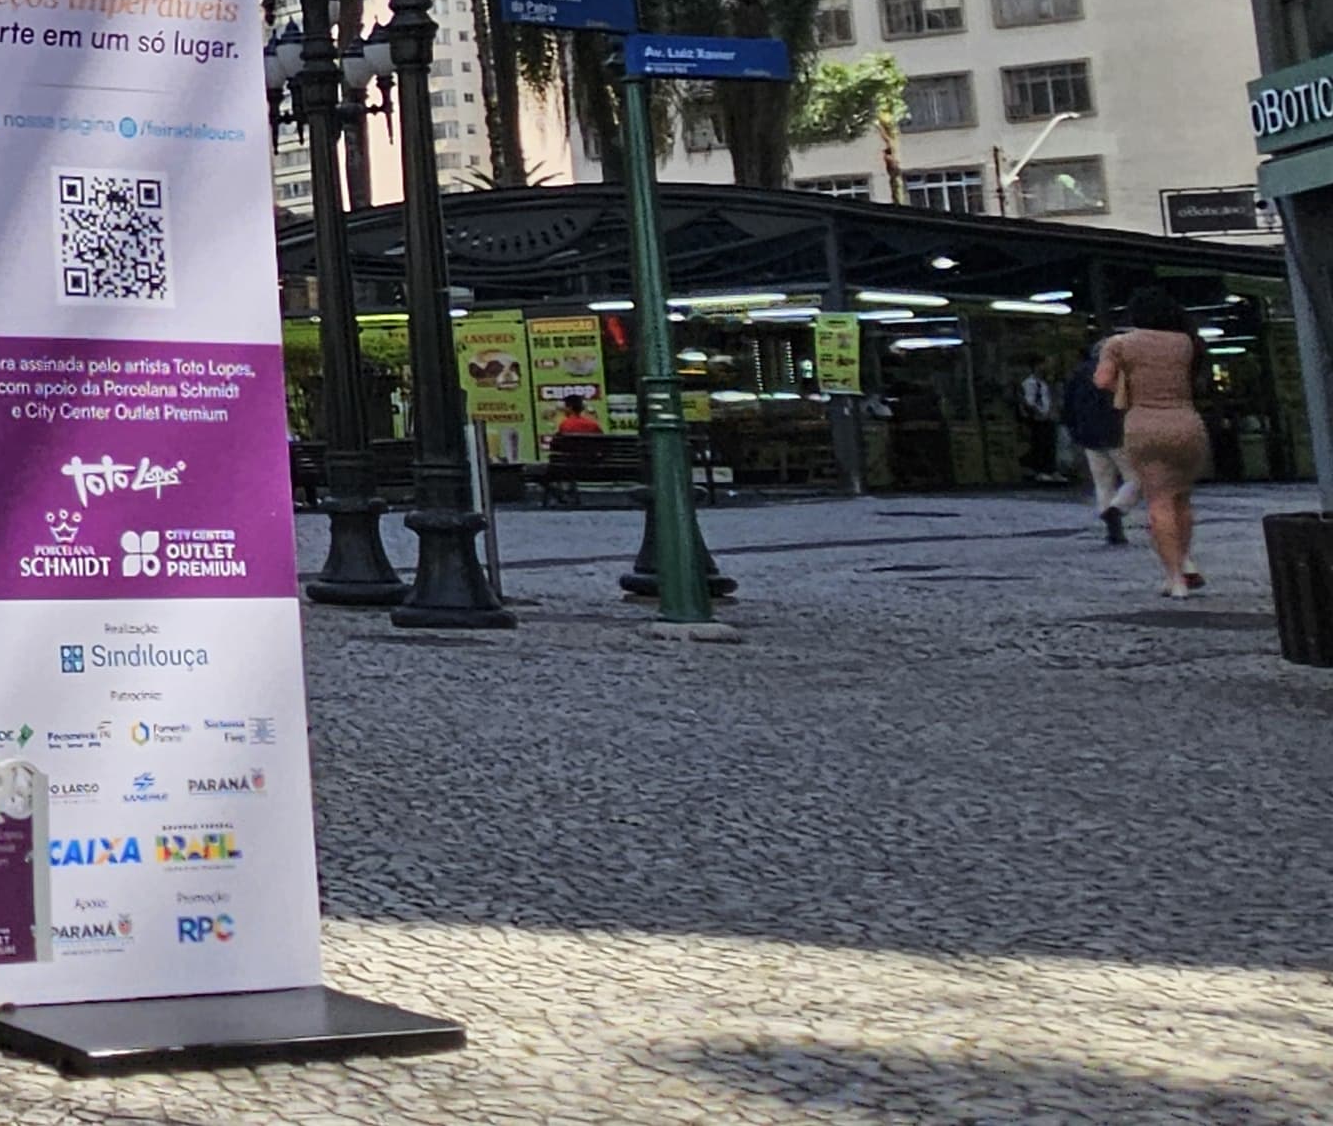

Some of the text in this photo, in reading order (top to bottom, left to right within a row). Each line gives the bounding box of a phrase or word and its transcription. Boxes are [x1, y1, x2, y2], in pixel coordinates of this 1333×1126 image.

[43, 30, 82, 49] em
[91, 32, 129, 53] um
[137, 33, 166, 55] só
[174, 31, 240, 64] lugar.
[645, 45, 666, 58] Av.
[20, 356, 85, 373] assinada
[88, 358, 121, 378] pelo
[124, 357, 171, 375] artista
[173, 358, 205, 376] Toto
[207, 359, 256, 380] Lopes,
[34, 381, 77, 400] apoio
[81, 380, 100, 397] da
[103, 380, 177, 398] Porcelana
[179, 381, 239, 399] Schmidt
[11, 403, 228, 425] e City Center Outlet Premium
[20, 542, 235, 578] SCHMIDT OUTLET
[34, 545, 96, 556] PORCELANA
[166, 560, 247, 578] PREMIUM
[91, 643, 209, 671] Sindilouça
[187, 775, 250, 793] PARANÁ
[49, 836, 142, 866] CAIXA
[178, 913, 235, 943] RPC
